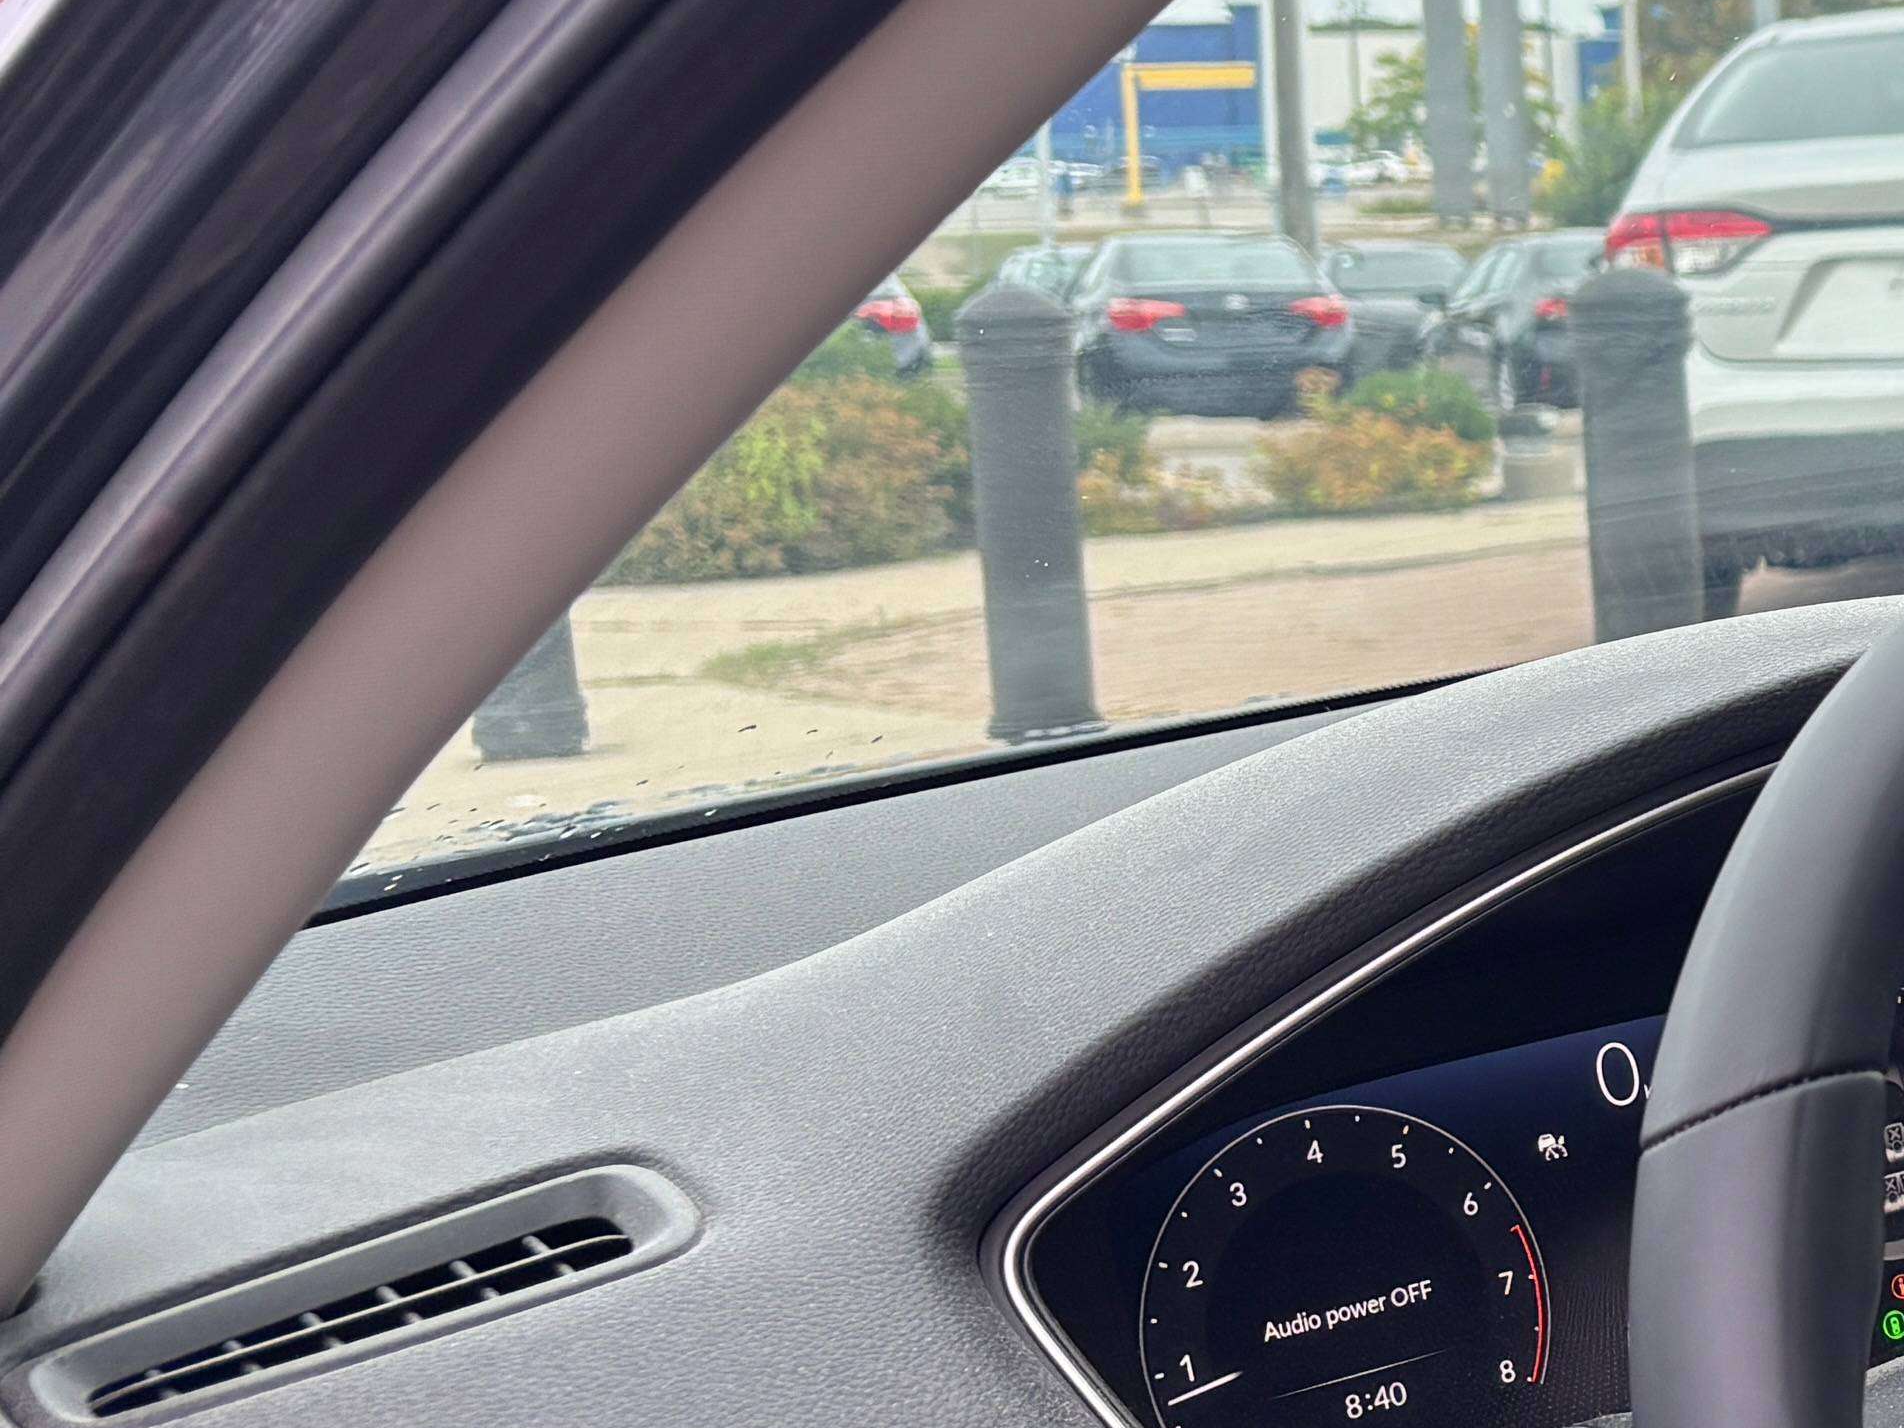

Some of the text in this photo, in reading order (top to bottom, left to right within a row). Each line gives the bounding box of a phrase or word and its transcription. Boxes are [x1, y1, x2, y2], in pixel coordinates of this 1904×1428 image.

[1596, 1041, 1640, 1107] 0
[1306, 1140, 1325, 1165] 4
[1390, 1145, 1407, 1169] 5
[1229, 1182, 1248, 1208] 3
[1462, 1192, 1480, 1216] 6
[1182, 1261, 1204, 1289] 2
[1498, 1271, 1516, 1295] 7
[1263, 1278, 1433, 1344] Audio power OFF
[1178, 1354, 1197, 1383] 1
[1499, 1359, 1517, 1384] 8
[1344, 1380, 1409, 1421] 8:40
